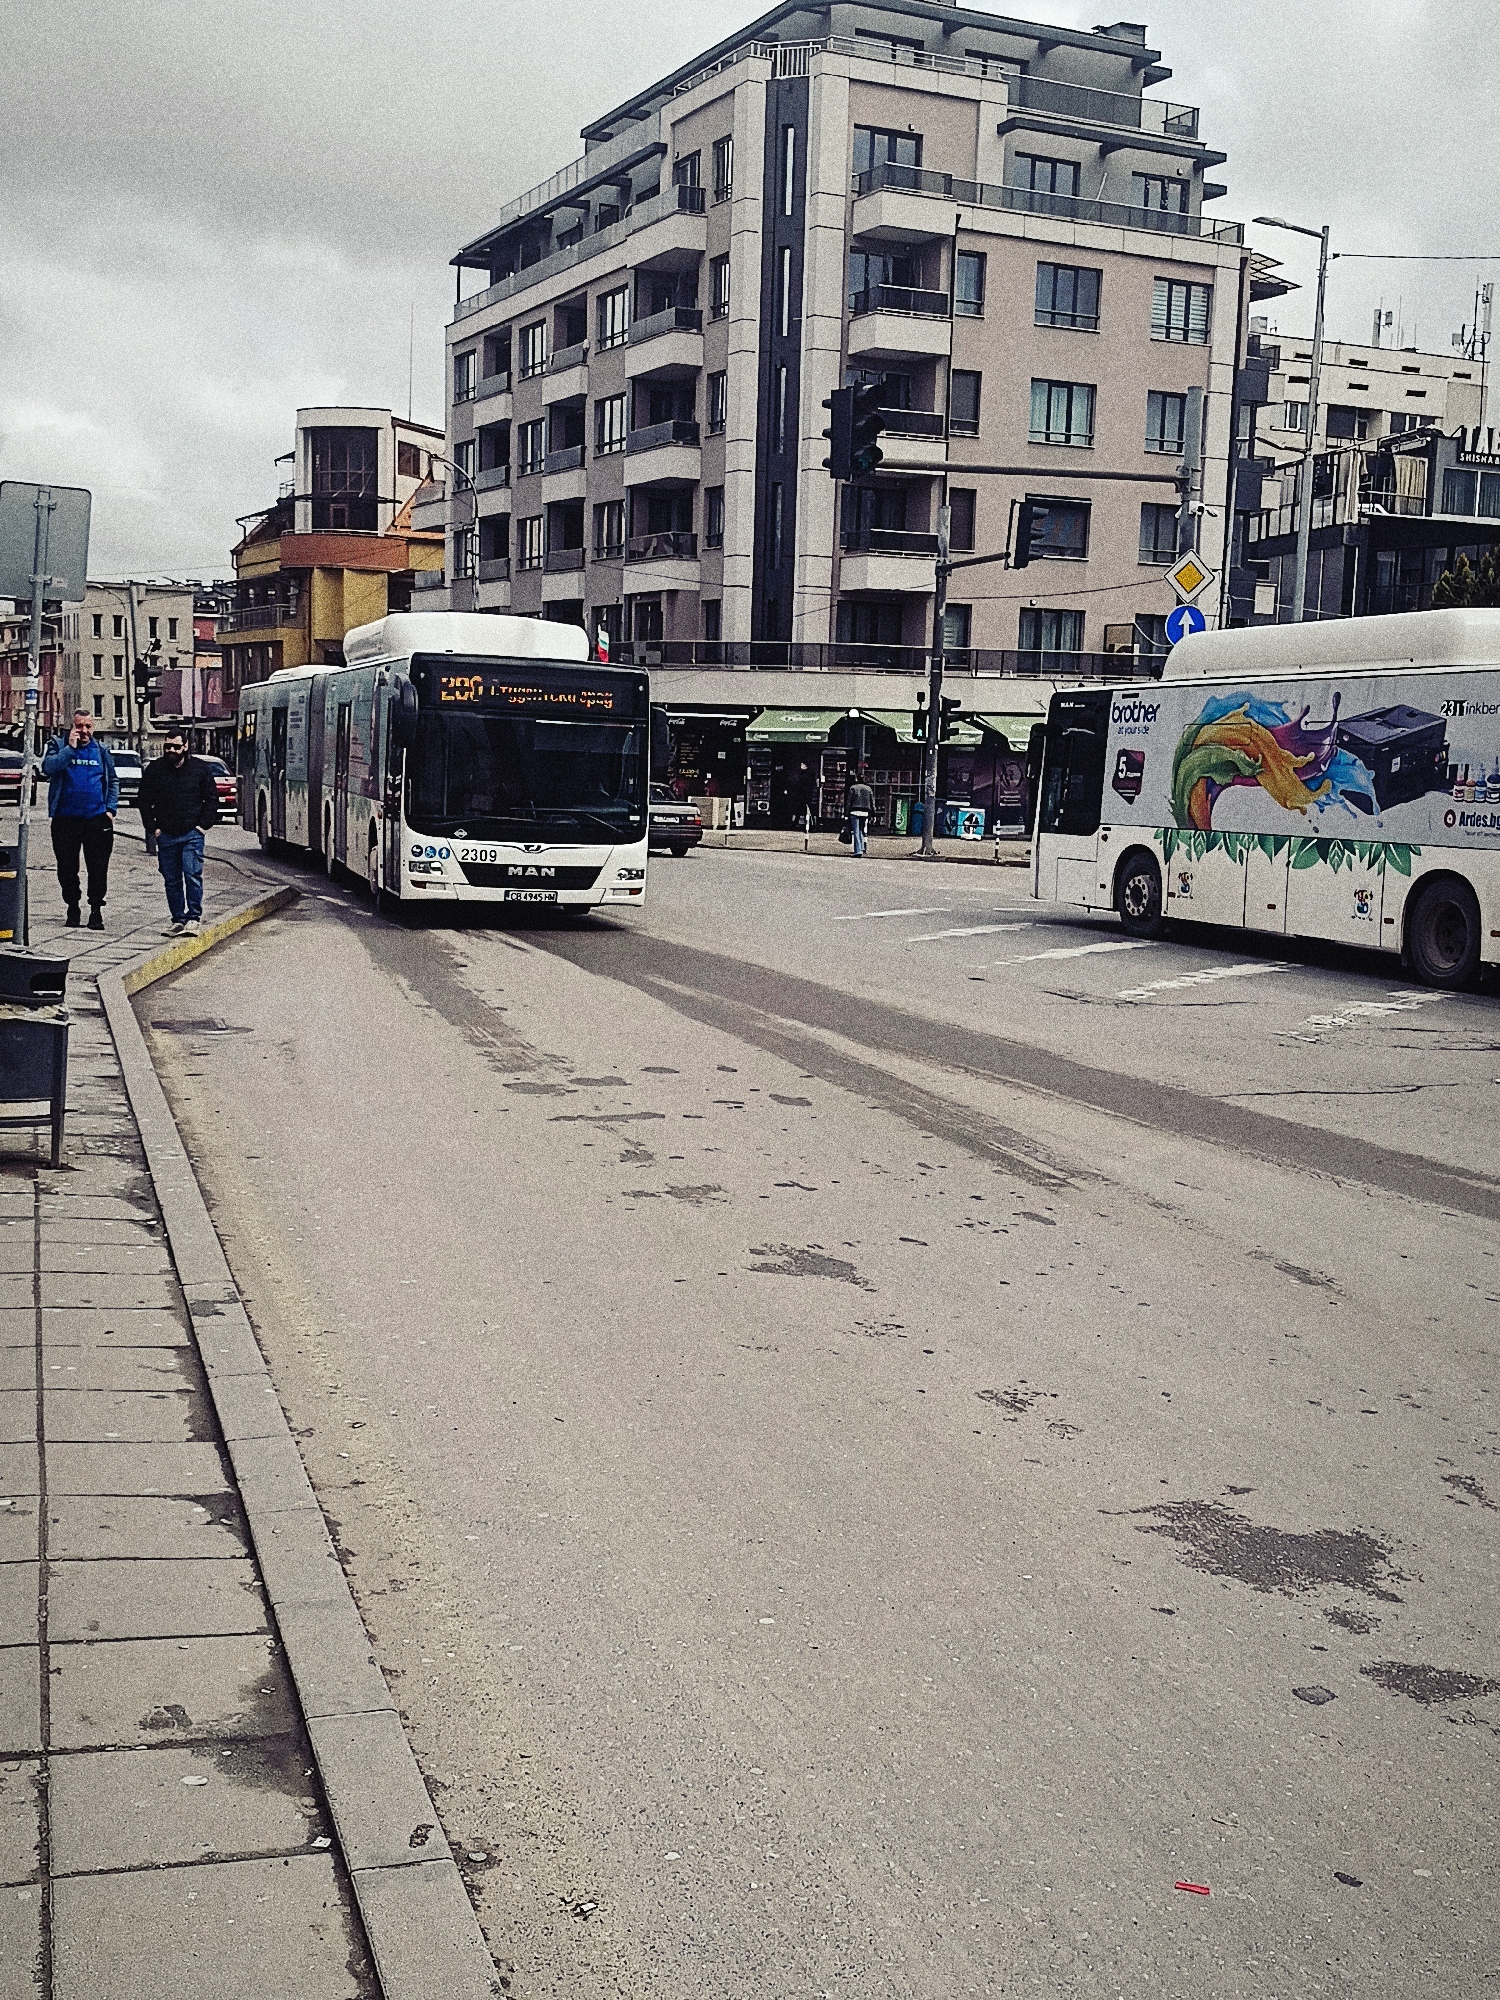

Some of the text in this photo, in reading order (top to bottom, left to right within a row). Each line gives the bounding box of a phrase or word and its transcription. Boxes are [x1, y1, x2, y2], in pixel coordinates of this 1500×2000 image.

[1111, 700, 1160, 723] brother
[1118, 756, 1127, 779] 5
[461, 848, 497, 862] 2309
[508, 866, 556, 877] MAN
